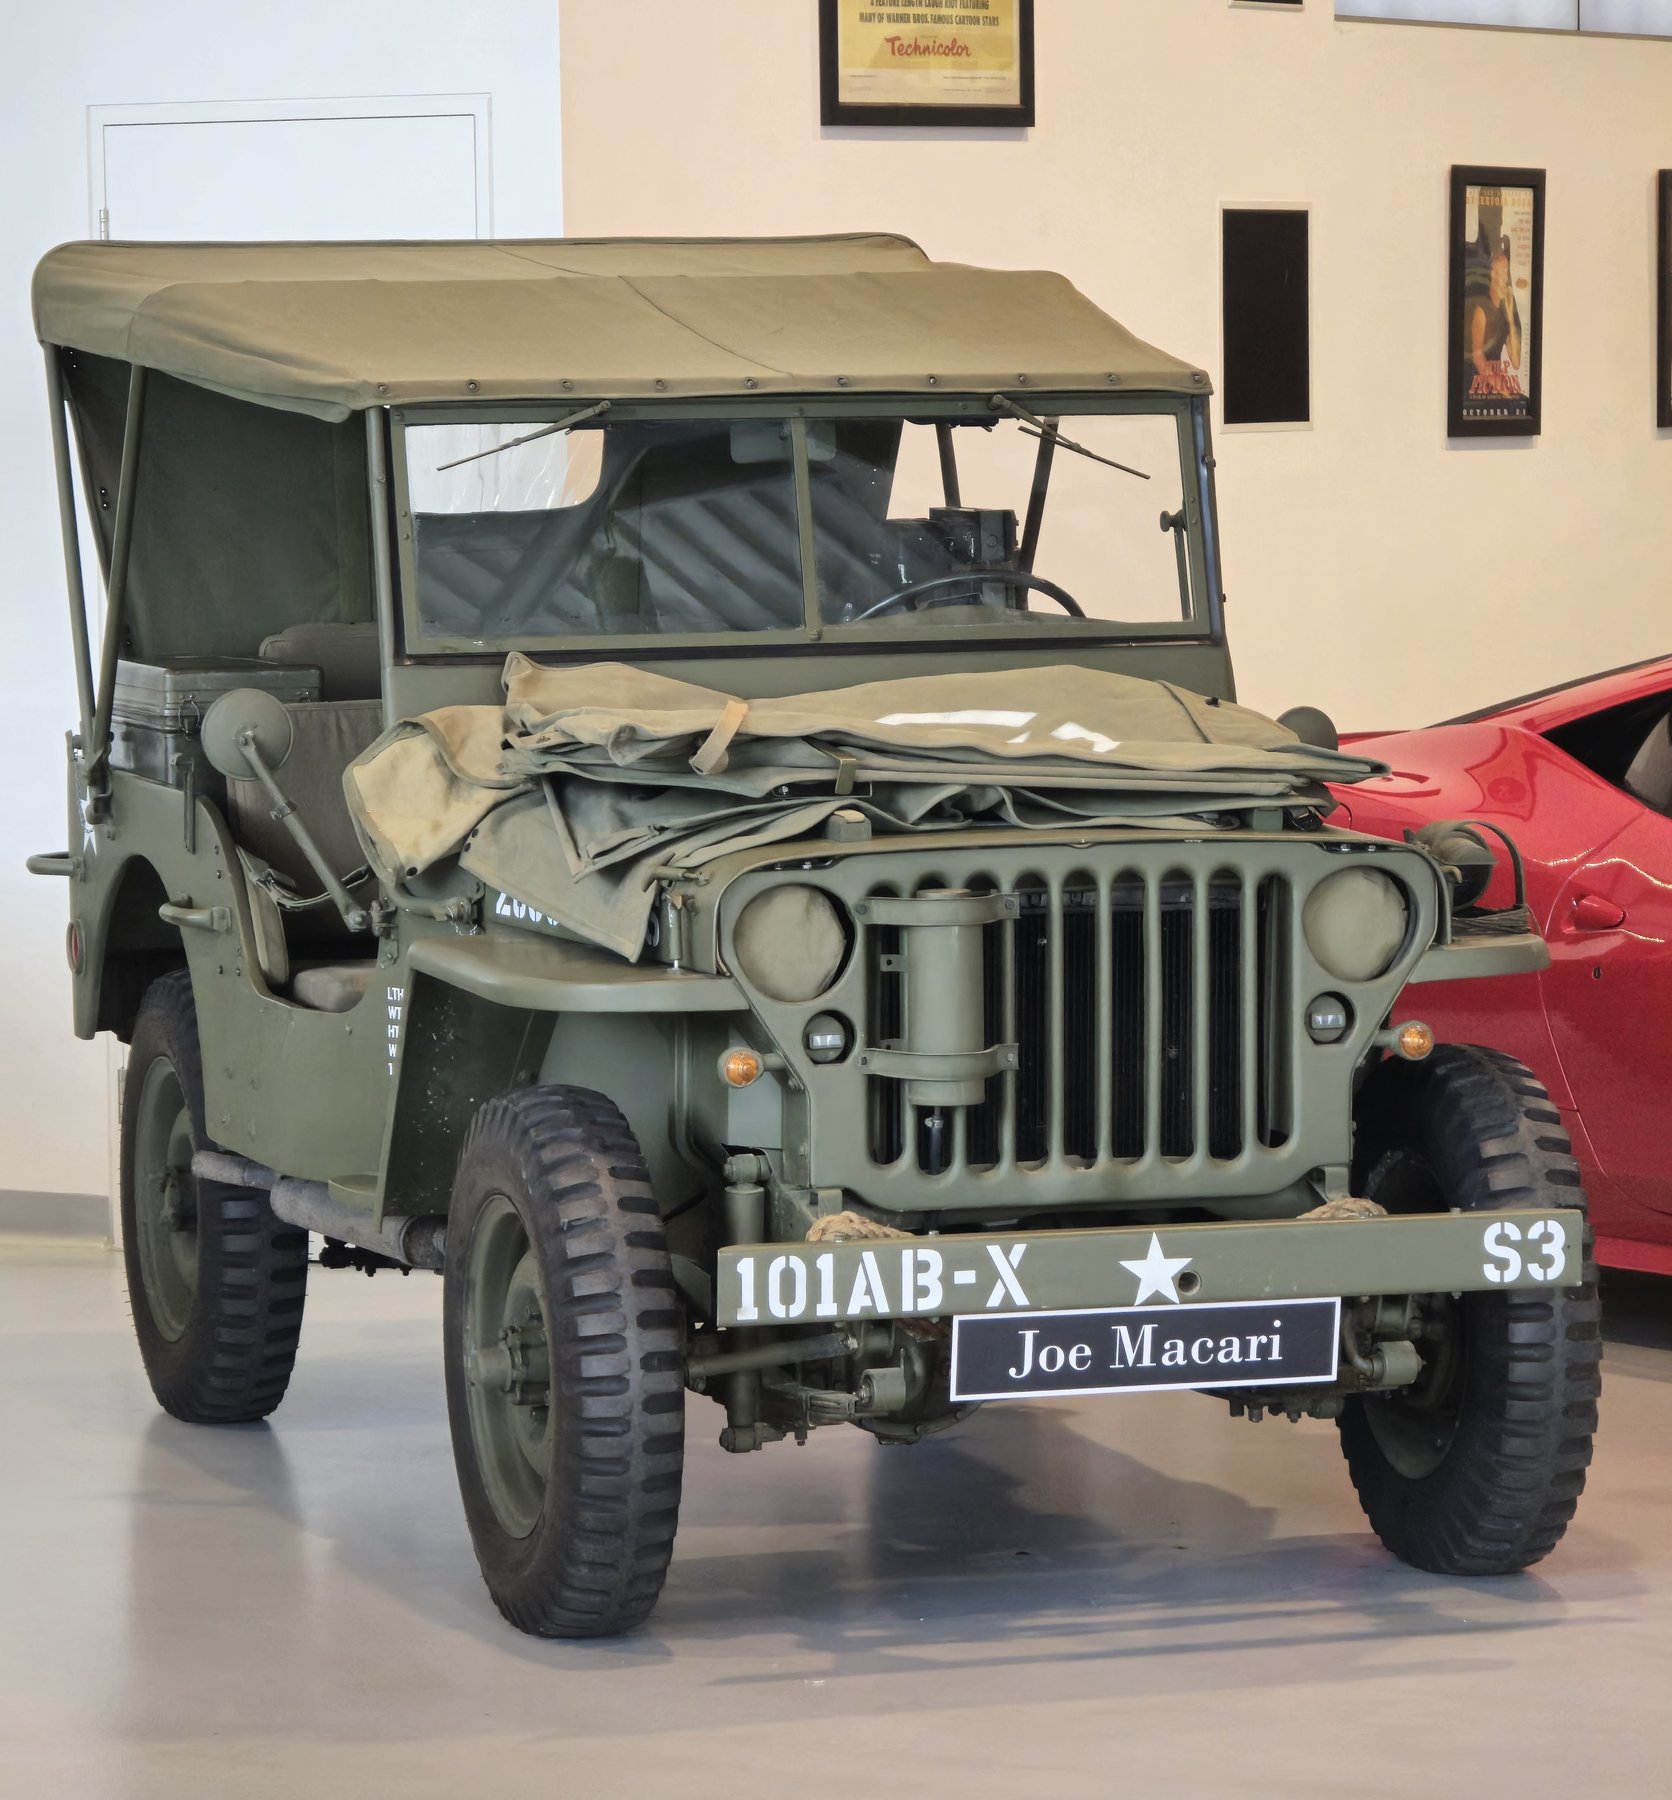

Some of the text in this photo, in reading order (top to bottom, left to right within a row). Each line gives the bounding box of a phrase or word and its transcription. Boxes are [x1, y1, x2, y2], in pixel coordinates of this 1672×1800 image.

[859, 12, 876, 23] MANY
[877, 12, 885, 23] OF
[886, 12, 911, 24] WARNER
[930, 14, 953, 25] FAMOUS
[955, 15, 981, 26] CARTOON
[982, 16, 999, 27] STARS
[884, 34, 972, 57] Technicolor
[1463, 408, 1508, 416] OCTOBER
[387, 986, 404, 1002] LTH
[387, 1005, 402, 1021] WT
[387, 1024, 400, 1039] HT
[388, 1043, 398, 1058] W
[1483, 1219, 1566, 1283] S3
[736, 1244, 1030, 1321] 101AB-X
[1008, 1319, 1283, 1379] Joe Macari
